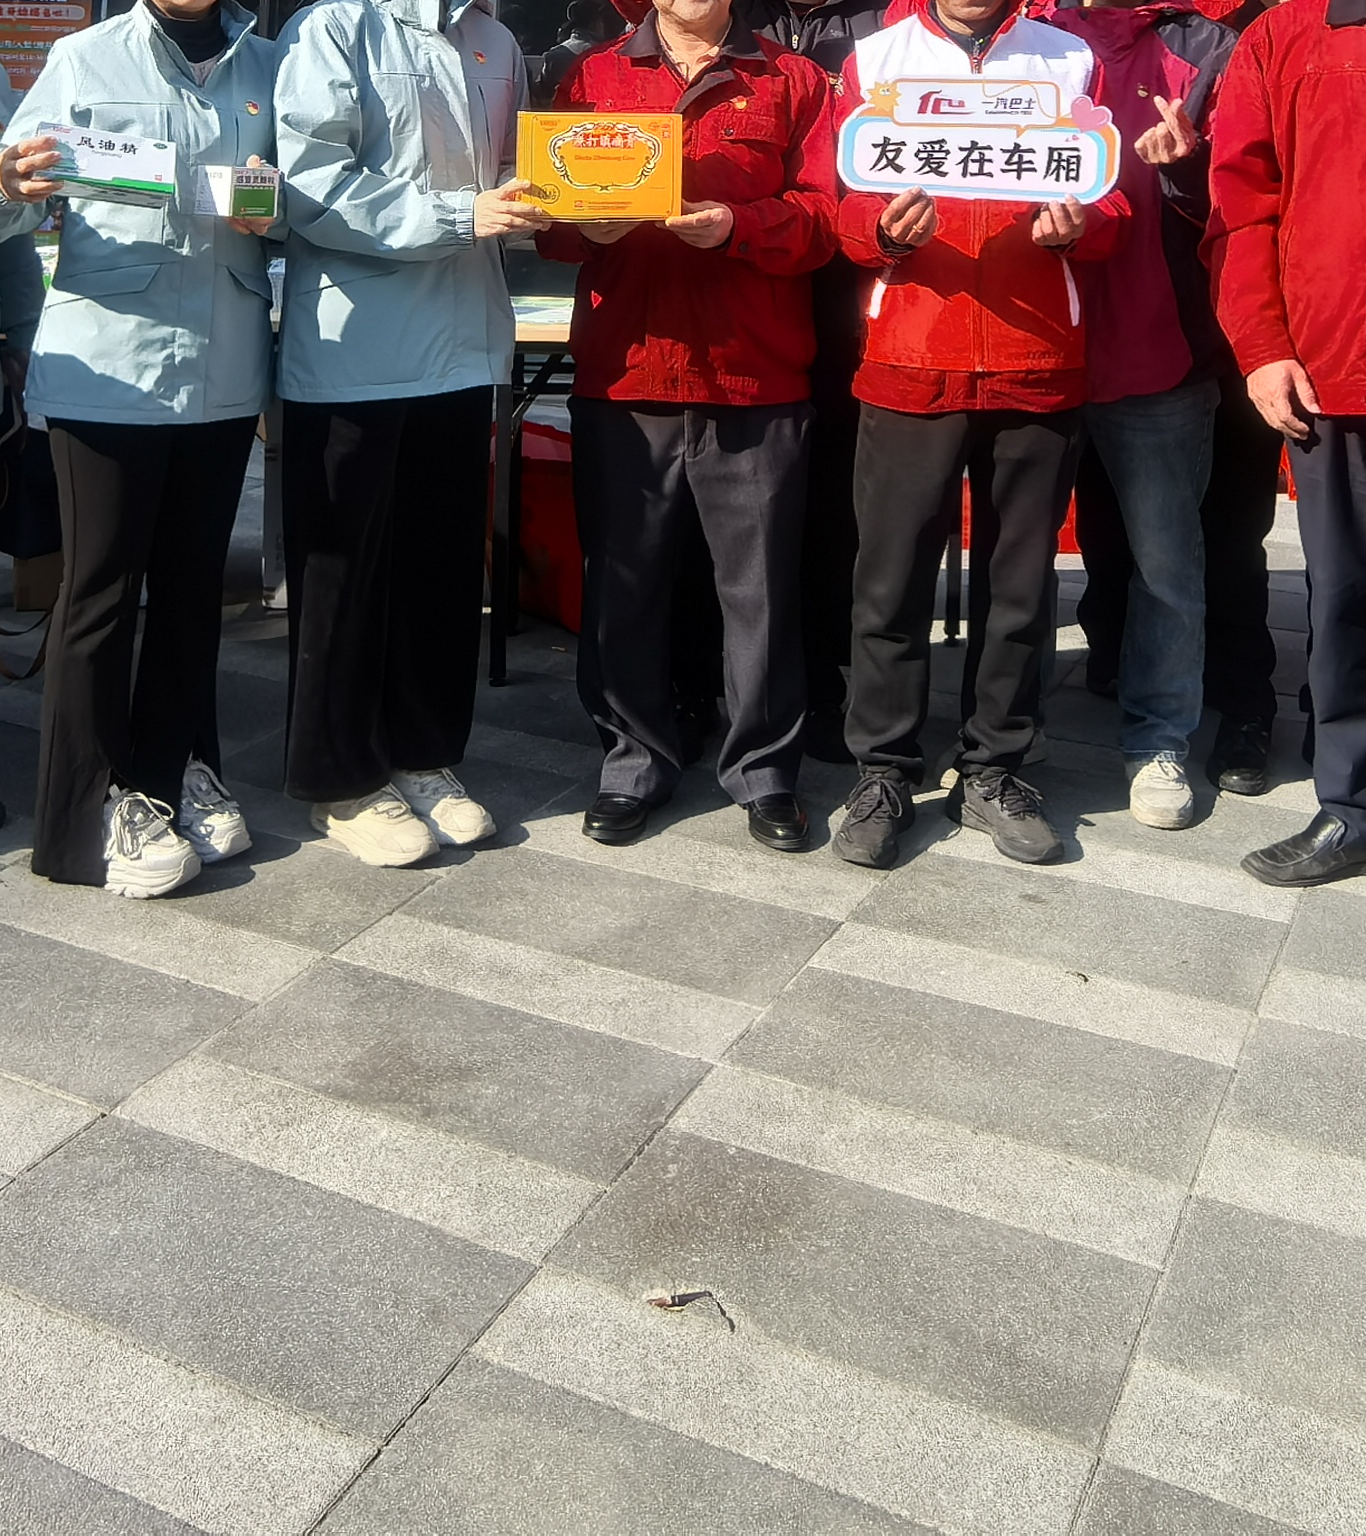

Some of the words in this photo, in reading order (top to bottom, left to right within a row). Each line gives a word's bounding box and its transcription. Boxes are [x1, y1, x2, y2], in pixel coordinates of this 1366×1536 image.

[868, 136, 1082, 184] 友爱在车厢
